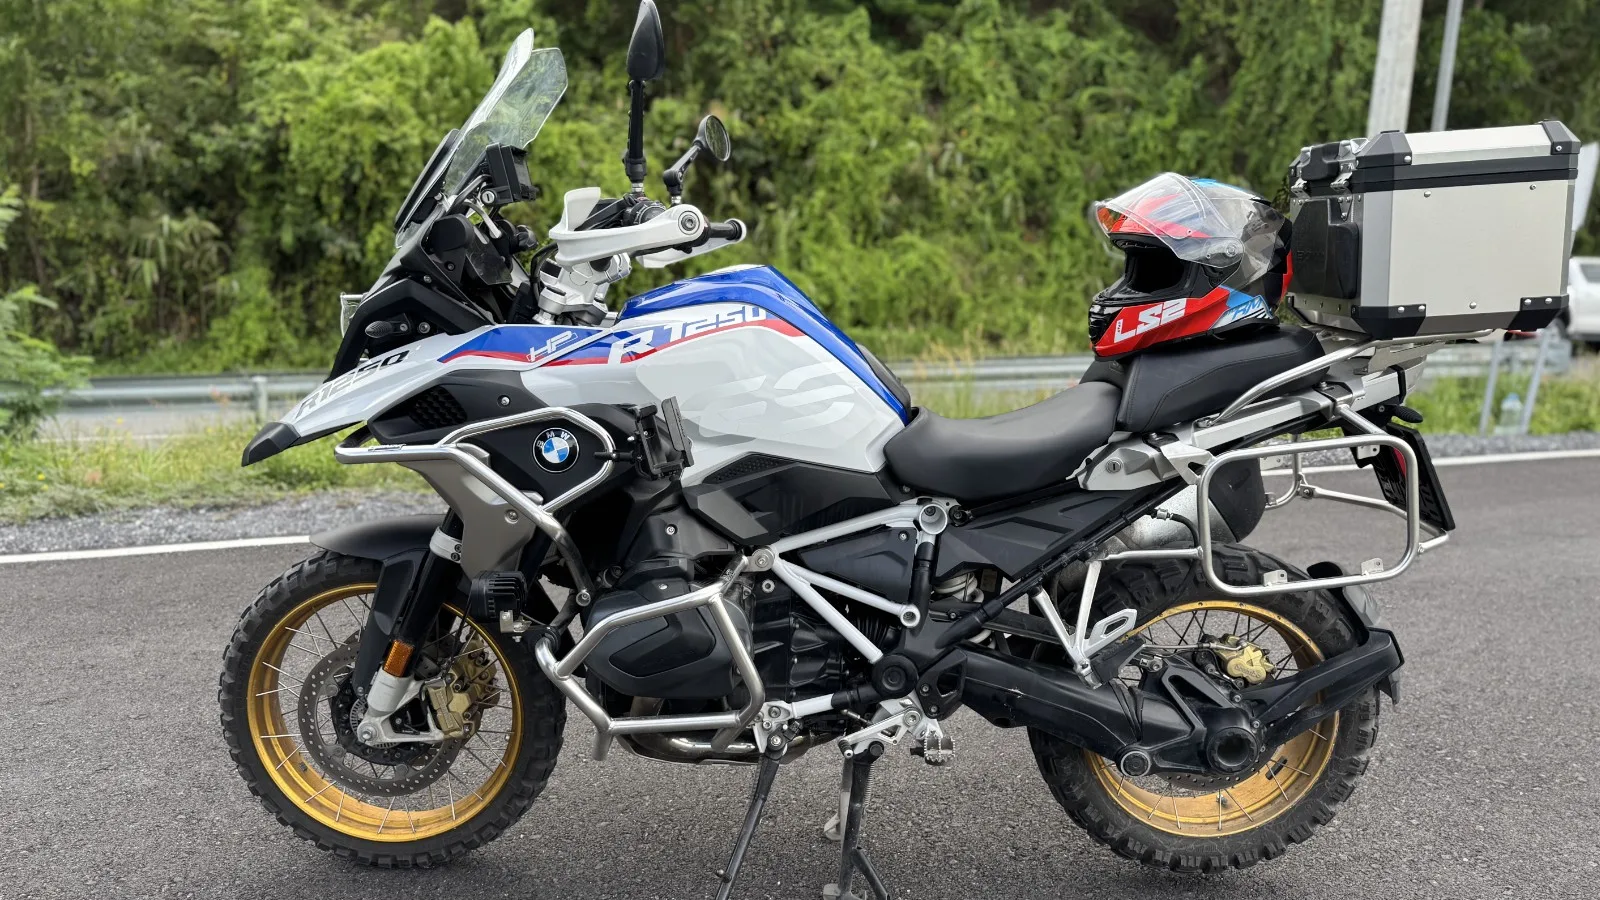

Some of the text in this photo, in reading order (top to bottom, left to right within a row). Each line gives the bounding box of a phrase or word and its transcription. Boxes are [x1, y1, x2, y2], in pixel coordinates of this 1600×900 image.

[1114, 298, 1187, 343] LS2
[527, 330, 578, 362] HP
[536, 430, 571, 449] BMW
